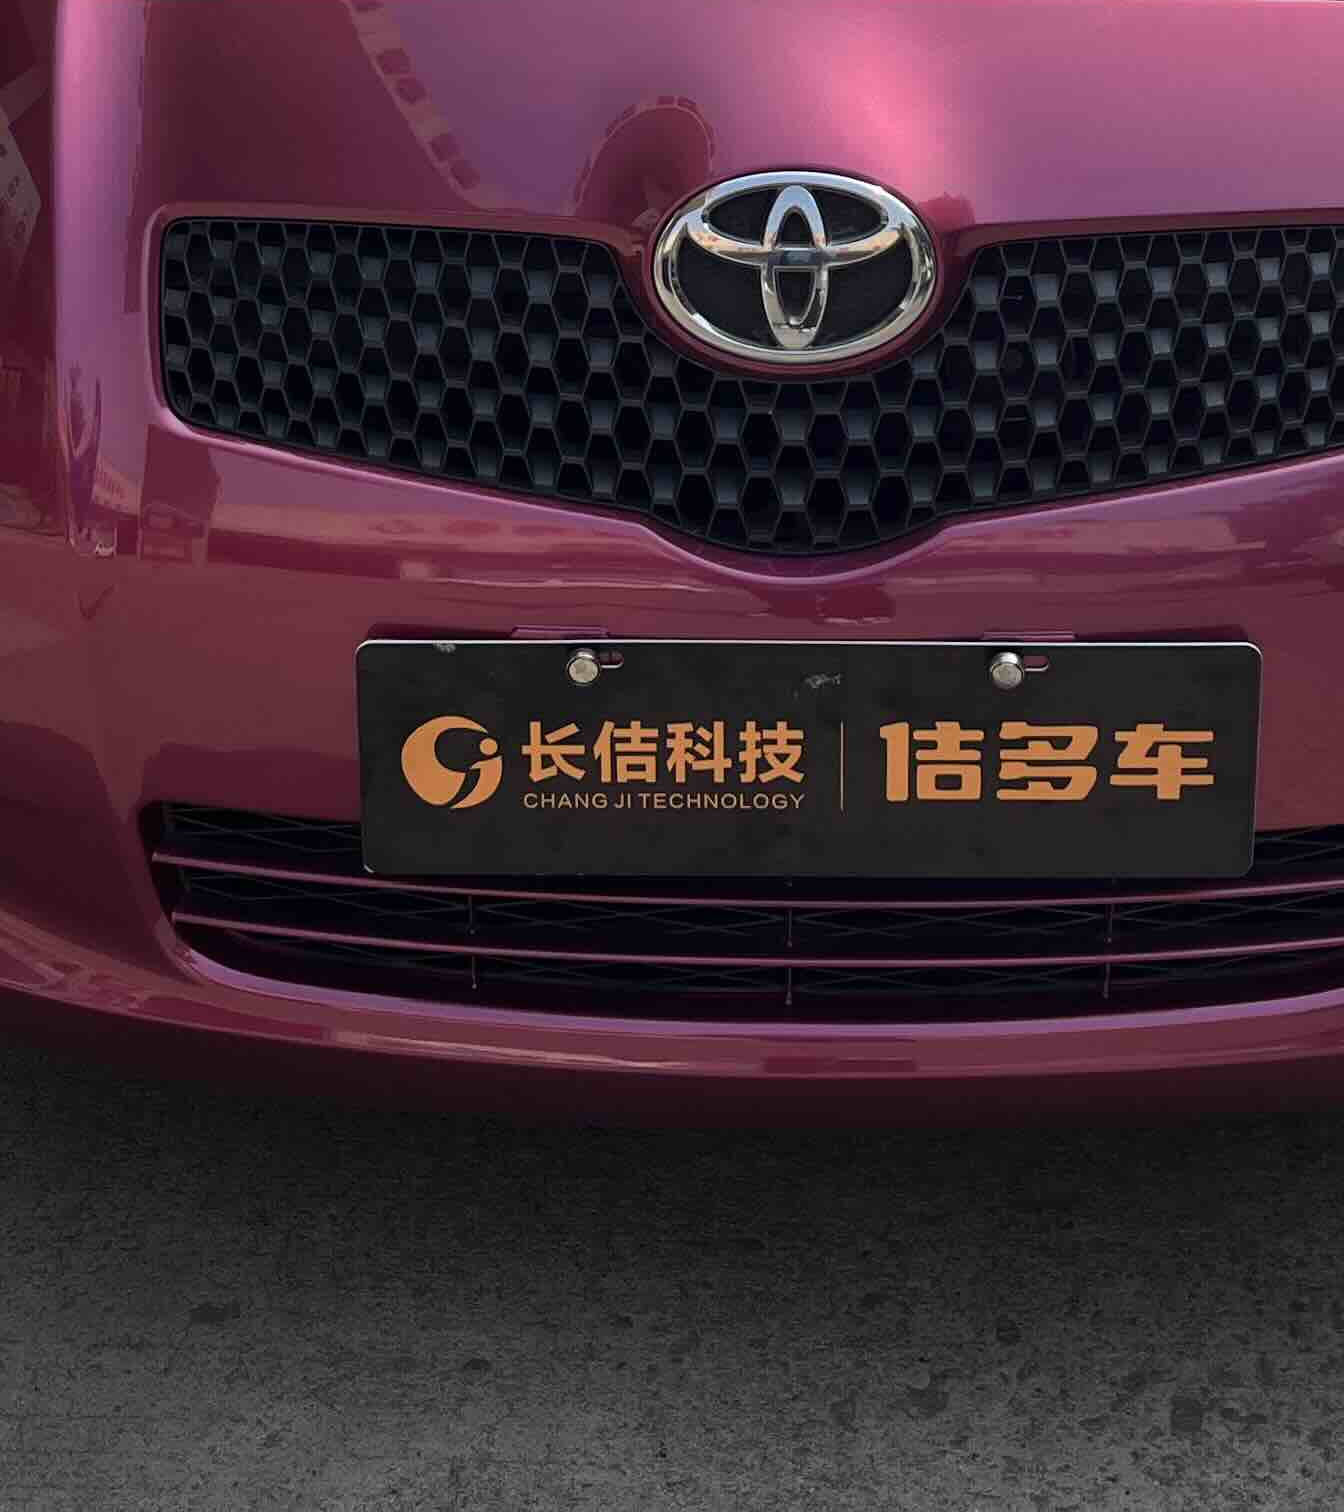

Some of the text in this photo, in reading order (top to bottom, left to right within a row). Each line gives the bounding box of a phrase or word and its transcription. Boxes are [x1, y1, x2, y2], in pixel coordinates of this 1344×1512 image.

[522, 721, 805, 783] 长佶科技
[879, 721, 1214, 801] 佶多车
[523, 792, 805, 809] CHANG JI TECHNOLOGY
